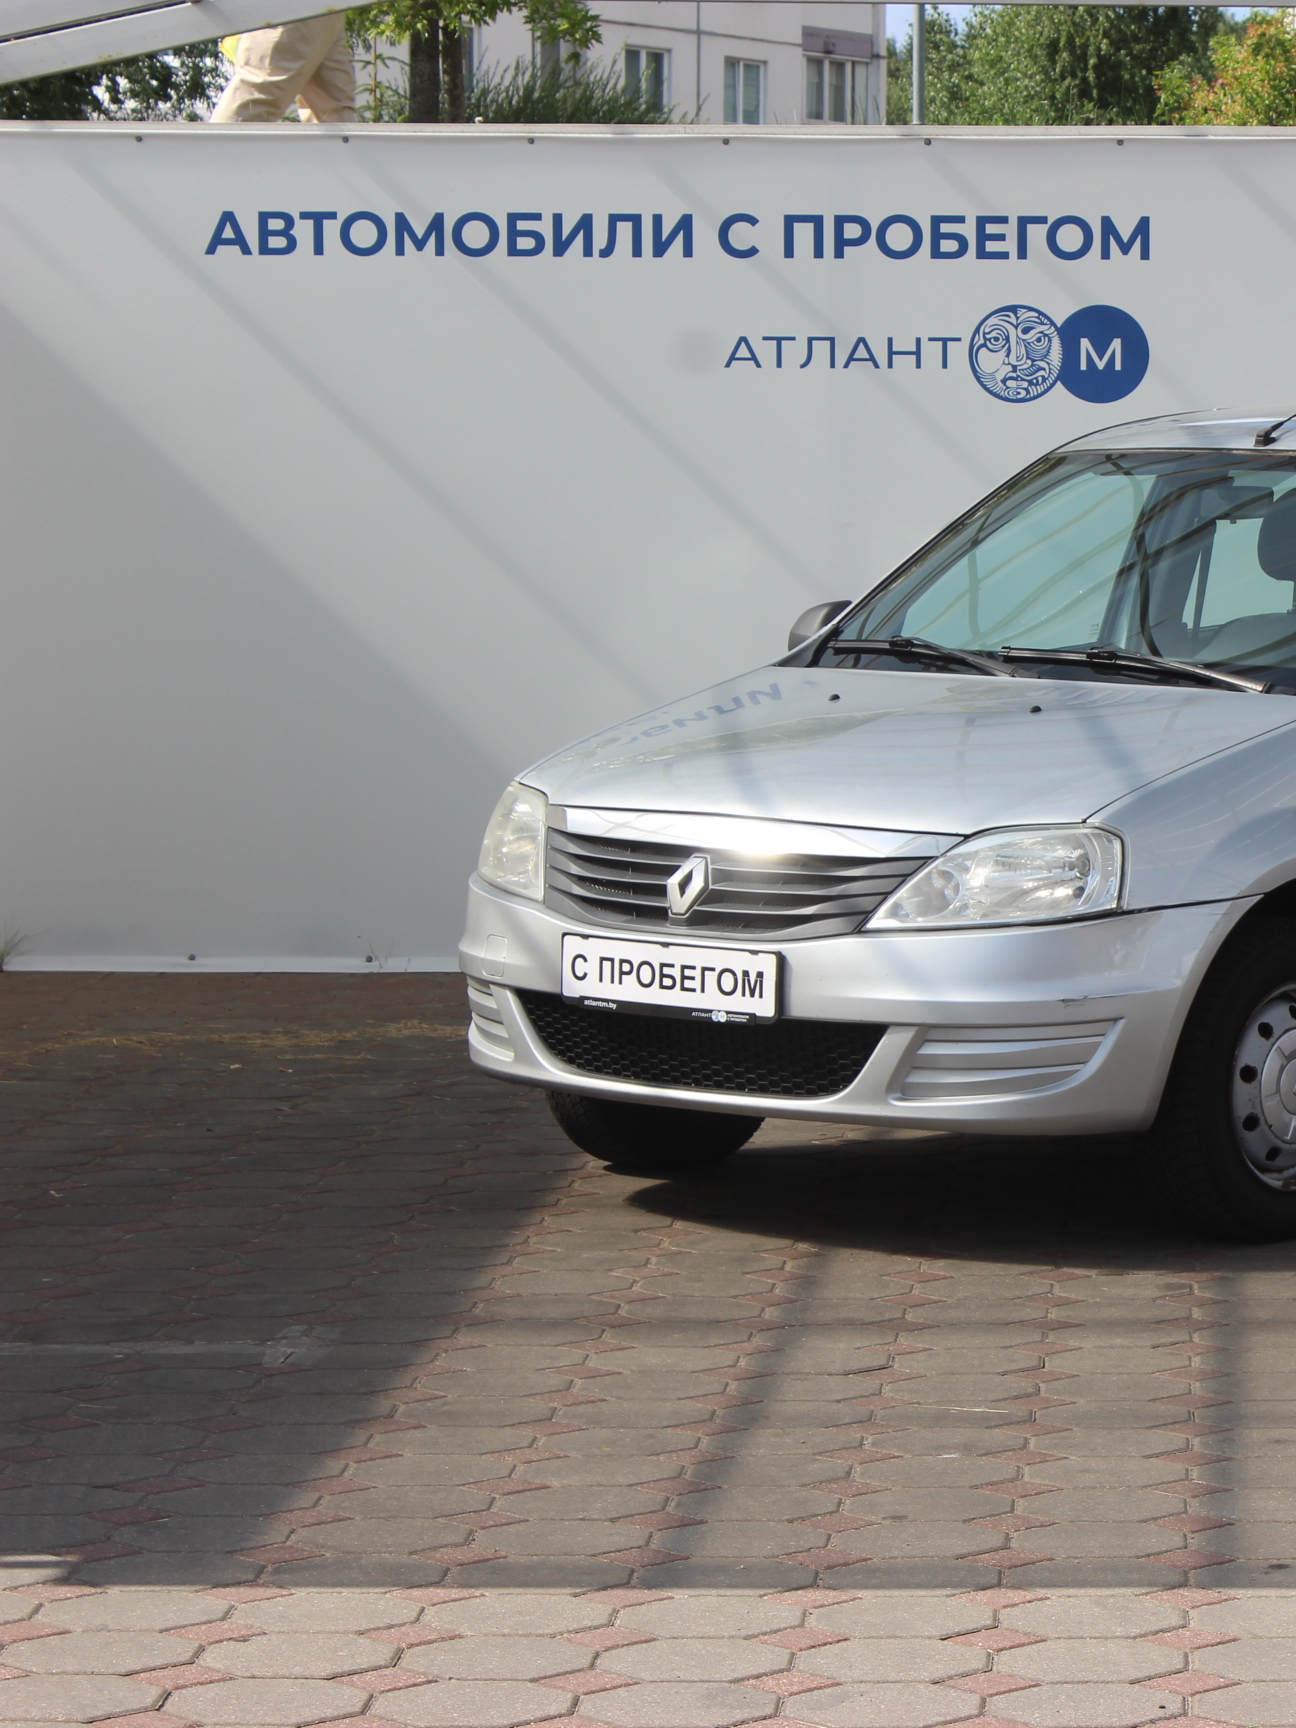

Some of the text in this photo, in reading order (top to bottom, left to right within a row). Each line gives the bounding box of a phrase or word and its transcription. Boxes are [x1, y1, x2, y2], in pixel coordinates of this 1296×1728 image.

[204, 210, 1152, 261] АВТОМОБИЛИ С ПРОБЕГОМ
[724, 335, 1123, 371] АТЛАНТ М
[570, 953, 765, 1000] С ПРОБЕГОМ
[583, 999, 618, 1010] atlantm.by
